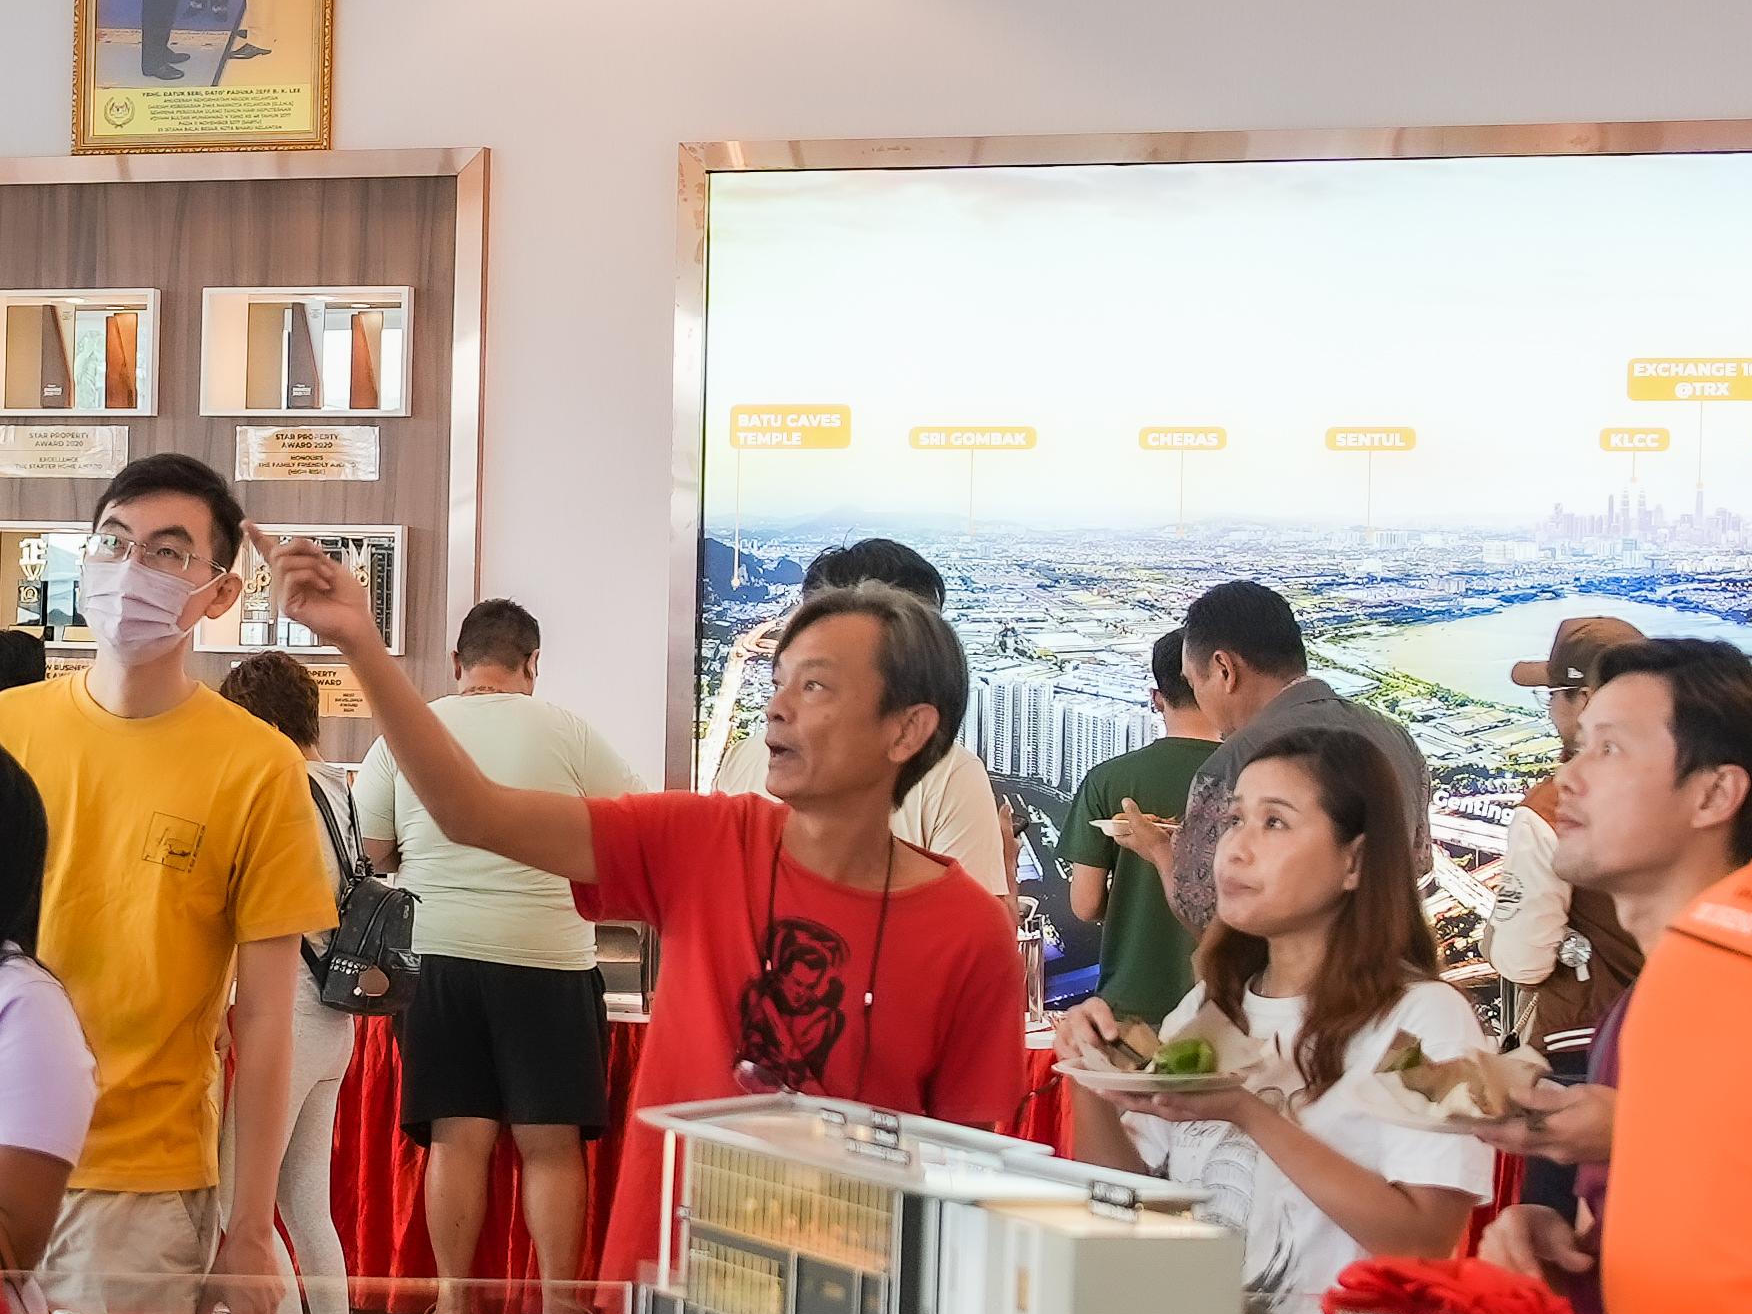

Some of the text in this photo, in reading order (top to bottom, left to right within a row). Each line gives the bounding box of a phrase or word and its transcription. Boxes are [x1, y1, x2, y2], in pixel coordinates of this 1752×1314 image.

[1633, 363, 1737, 377] EXCHANGE
[1675, 382, 1730, 399] @TRX
[737, 414, 842, 427] BATU CAVES
[737, 432, 802, 446] TEMPLE
[918, 432, 1027, 446] SRI GOMBAK
[1147, 432, 1219, 446] CHERAS
[1335, 432, 1406, 447] SENTUL
[1609, 433, 1660, 448] KLCC
[1432, 790, 1516, 826] Genting
